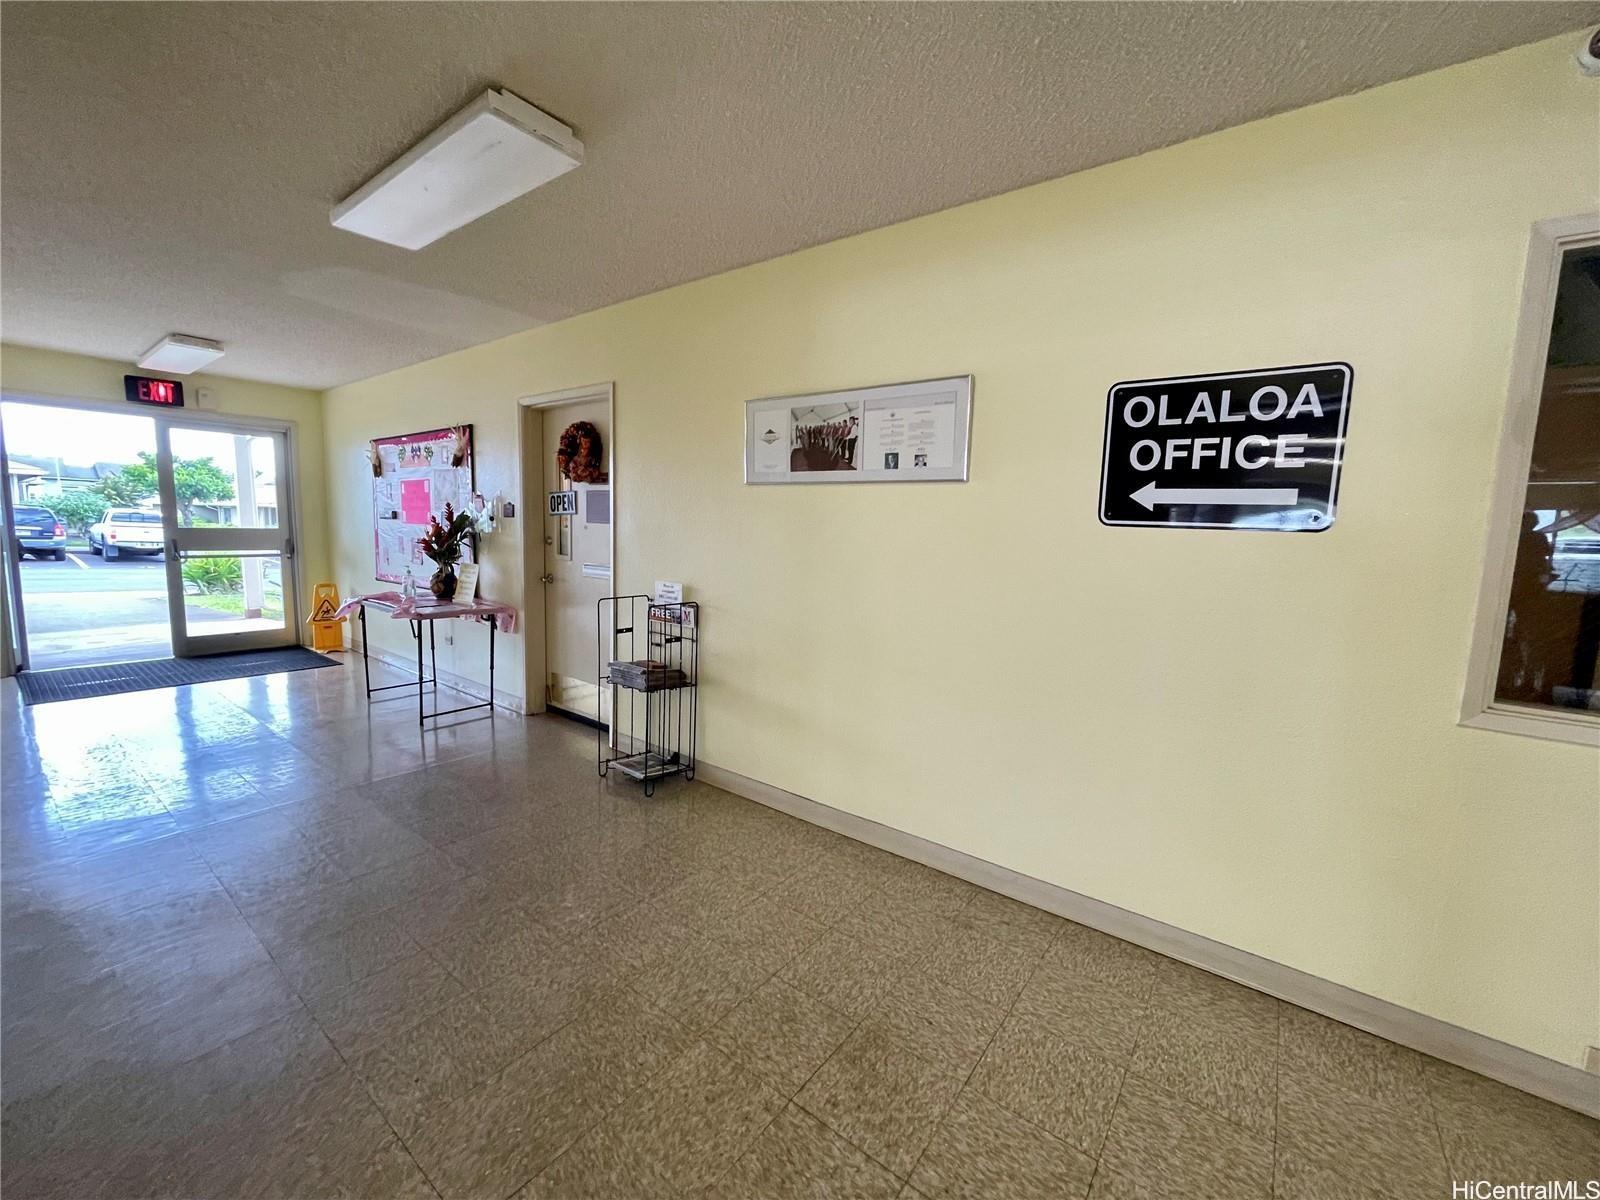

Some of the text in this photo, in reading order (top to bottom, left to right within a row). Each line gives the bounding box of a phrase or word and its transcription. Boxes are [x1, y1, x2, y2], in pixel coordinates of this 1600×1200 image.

[138, 380, 175, 404] EXIT
[1123, 383, 1324, 428] OLALOA
[1129, 433, 1309, 472] OFFICE
[550, 493, 574, 512] OPEN
[651, 607, 672, 619] FREE
